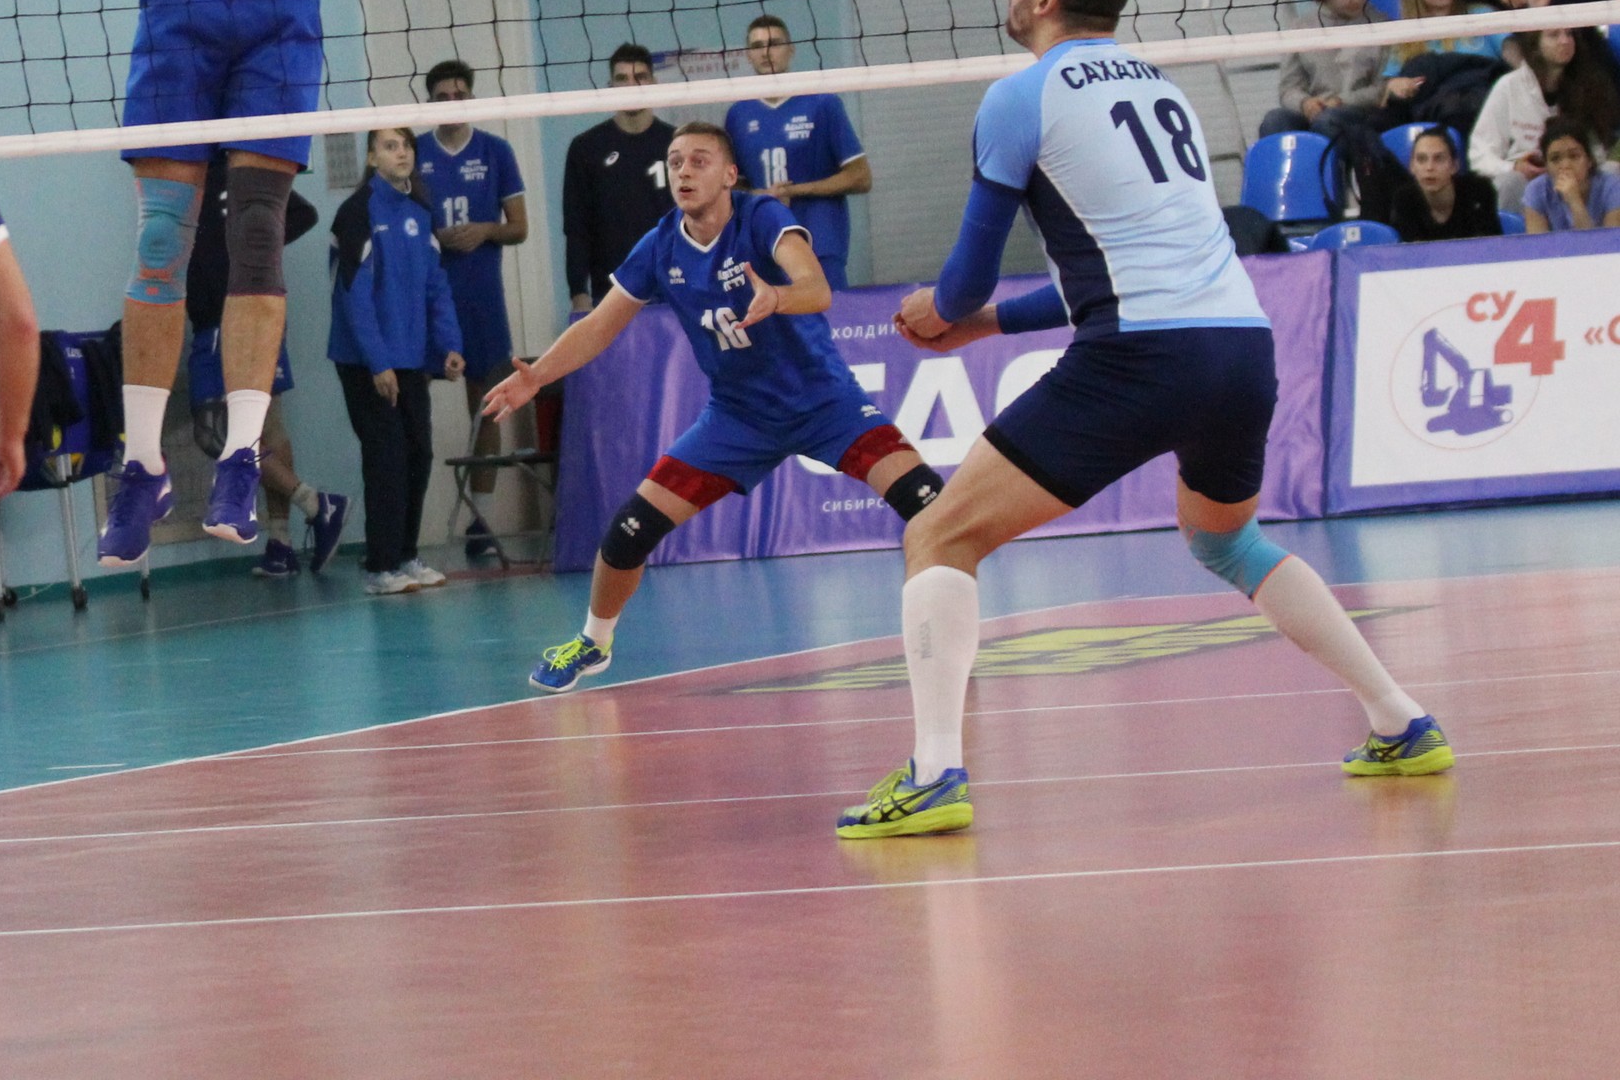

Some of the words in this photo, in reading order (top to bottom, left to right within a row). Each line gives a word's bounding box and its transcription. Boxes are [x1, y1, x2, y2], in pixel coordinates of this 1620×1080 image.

[1060, 60, 1174, 90] САХАЛИ
[1110, 98, 1206, 184] 18
[701, 307, 752, 351] 16
[1466, 290, 1516, 322] СУ
[1494, 297, 1566, 376] 4
[822, 497, 891, 512] СИБИРС
